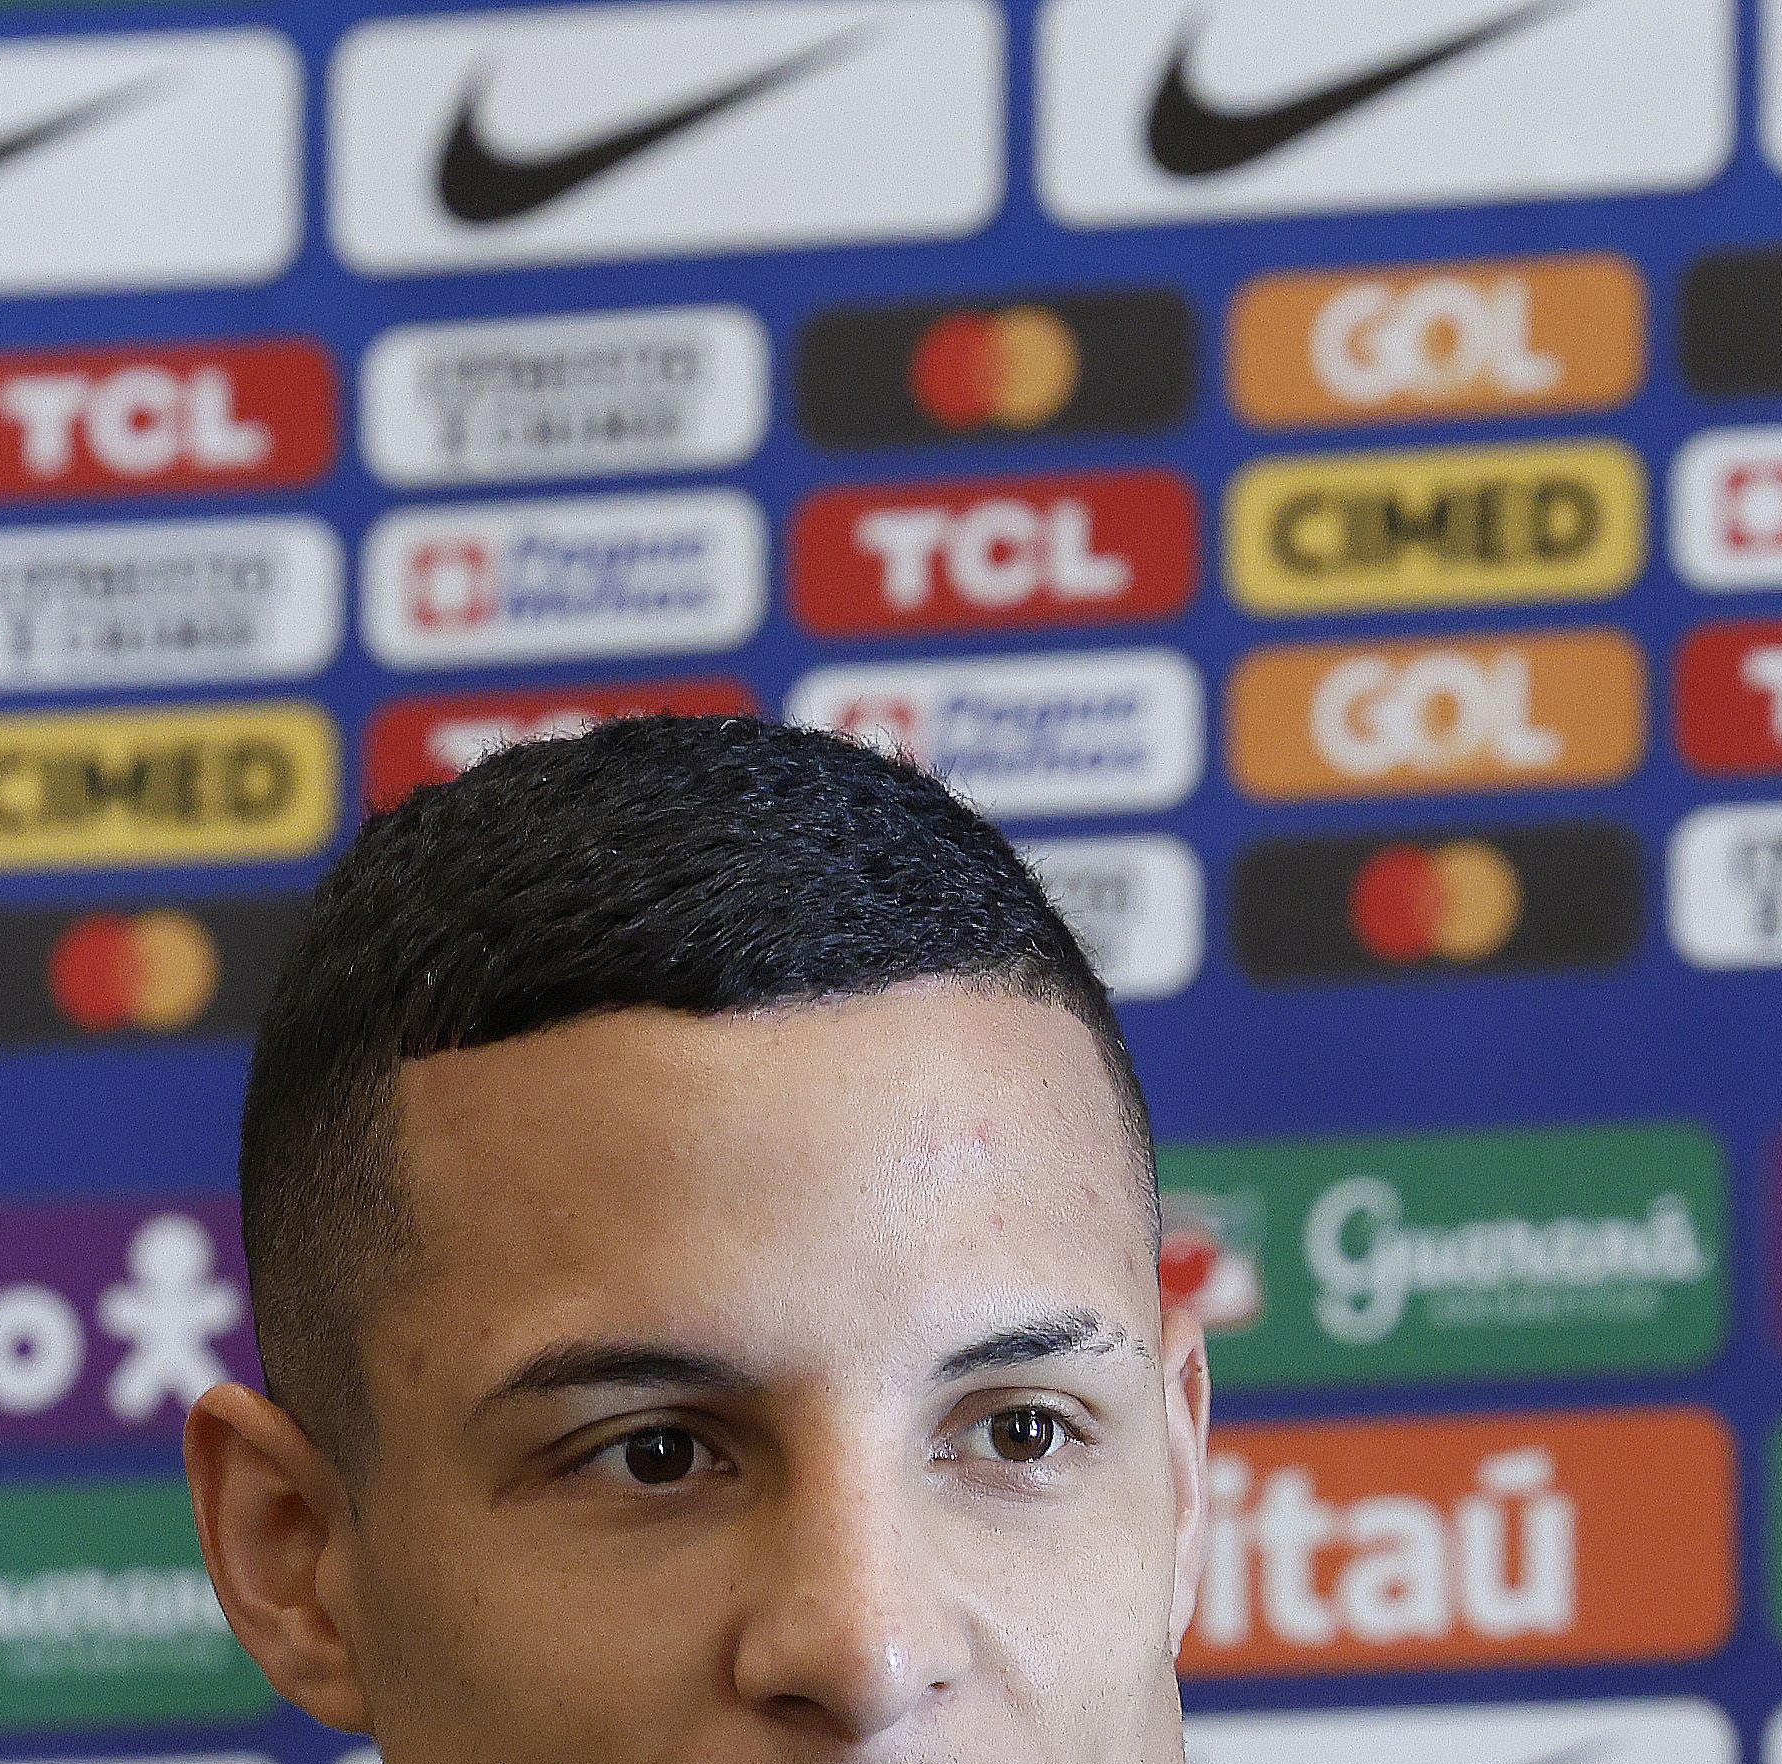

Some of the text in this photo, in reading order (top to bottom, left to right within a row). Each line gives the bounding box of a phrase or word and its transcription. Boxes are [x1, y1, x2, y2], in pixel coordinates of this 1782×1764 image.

[1311, 277, 1558, 402] GOL
[857, 500, 1128, 607] TCL
[1270, 479, 1602, 576] CIMED
[1311, 651, 1560, 775] GOL
[1202, 1448, 1576, 1648] itaú
